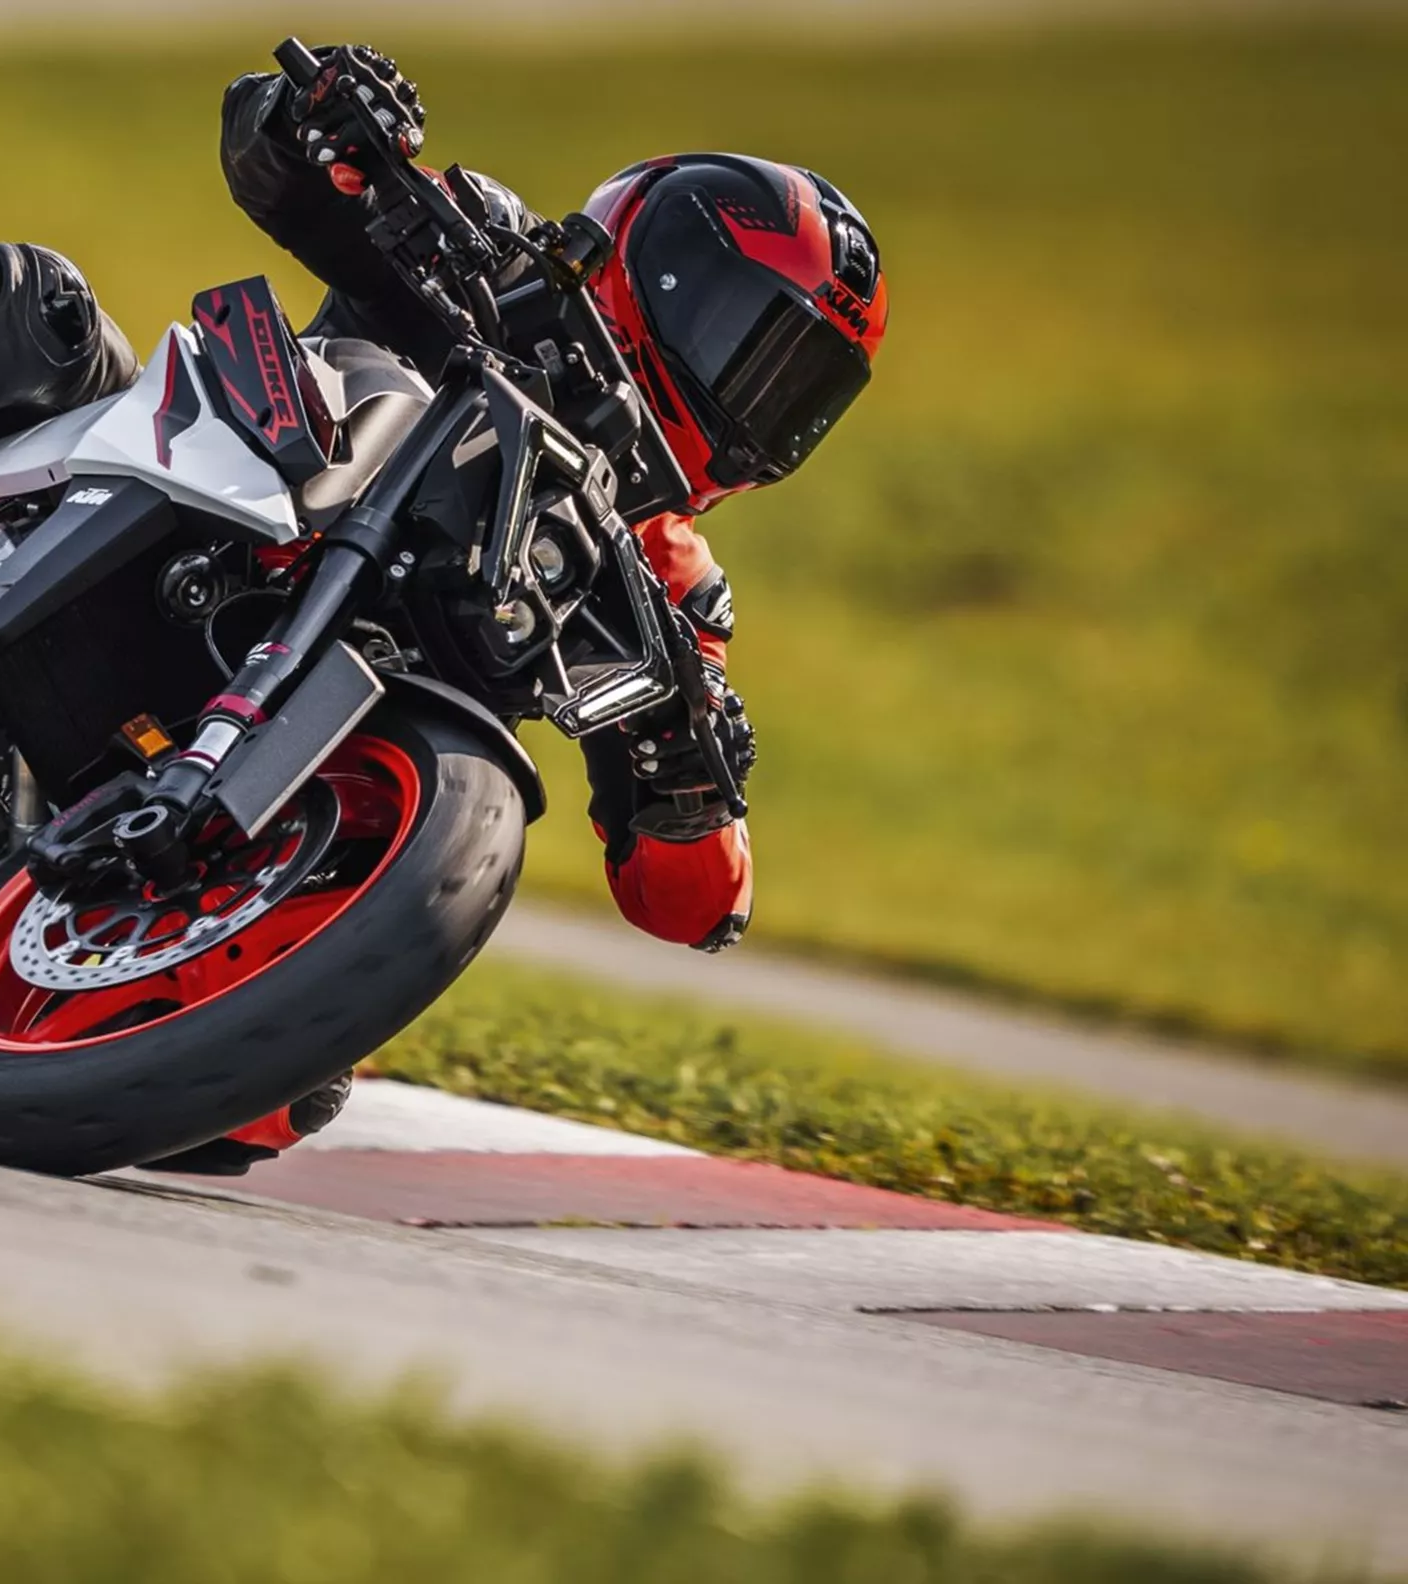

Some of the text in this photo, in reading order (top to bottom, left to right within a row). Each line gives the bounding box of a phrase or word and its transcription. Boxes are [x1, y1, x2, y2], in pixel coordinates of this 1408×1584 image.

[814, 280, 869, 336] KTM
[251, 313, 296, 426] DUKE
[66, 487, 113, 506] KTM
